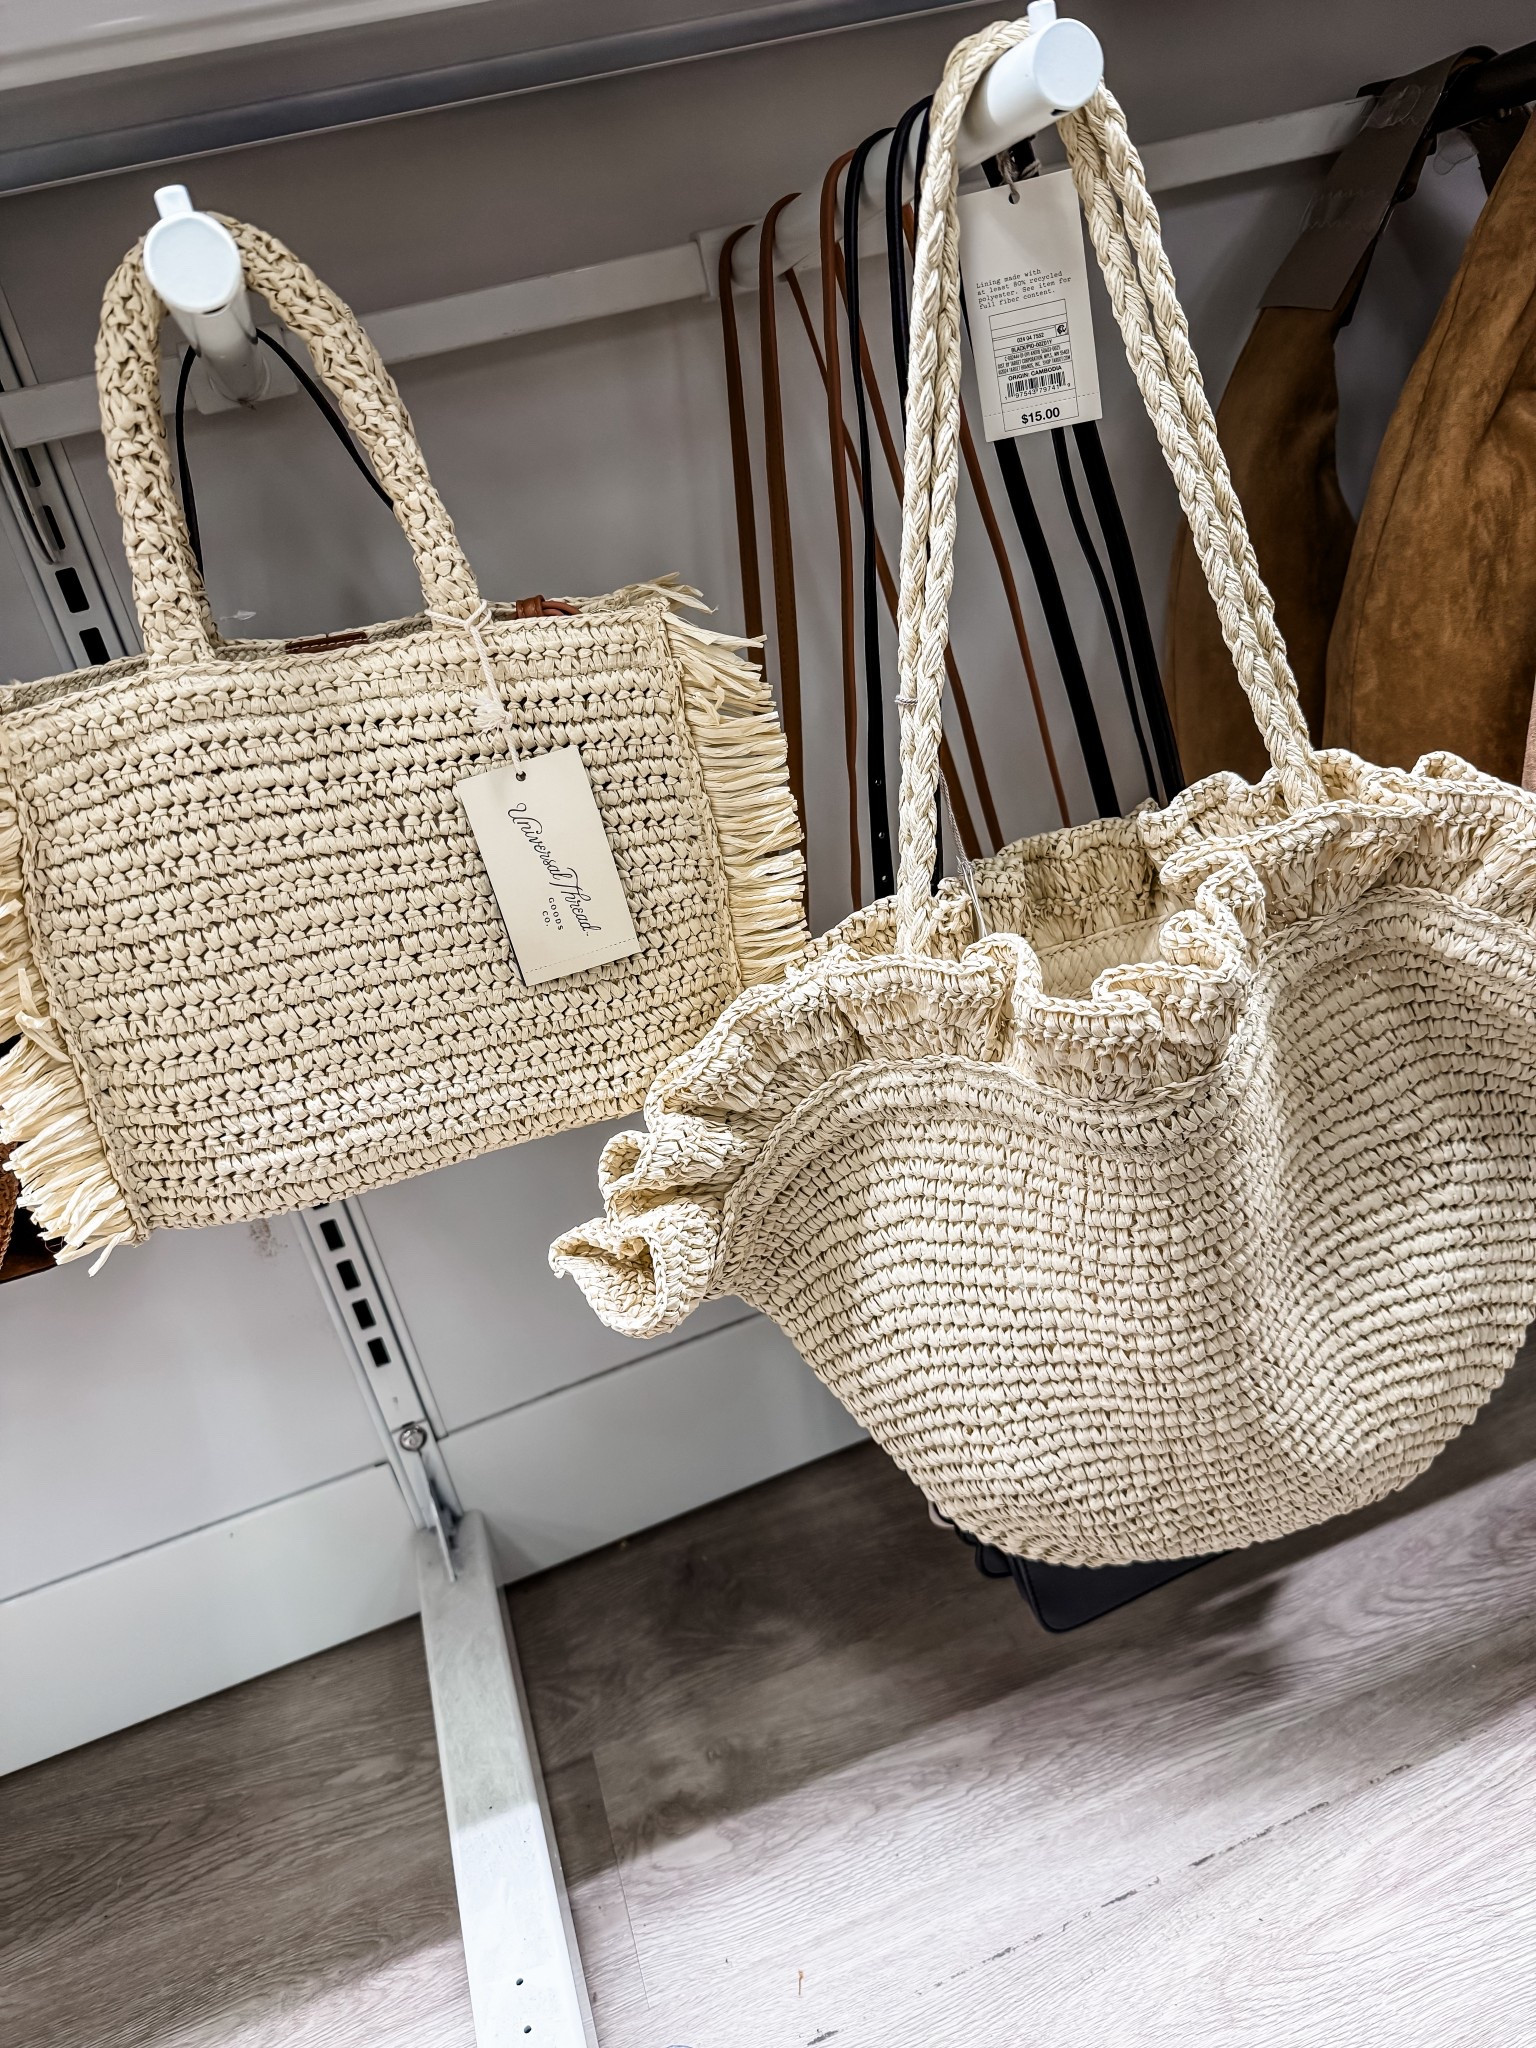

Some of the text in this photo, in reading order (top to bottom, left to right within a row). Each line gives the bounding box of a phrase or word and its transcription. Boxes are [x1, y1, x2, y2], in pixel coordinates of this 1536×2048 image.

[976, 268, 1041, 289] Lining made with
[989, 284, 1010, 293] least
[1029, 271, 1063, 284] recycled
[978, 290, 1018, 305] polyester.
[1022, 285, 1035, 293] See
[1039, 281, 1055, 289] item
[979, 288, 1055, 310] full fiber content.
[1030, 365, 1063, 376] CAMBODIA
[1021, 406, 1060, 425] $15.00
[507, 802, 573, 881] Universal
[542, 910, 551, 927] CO.
[548, 897, 564, 931] GOODS
